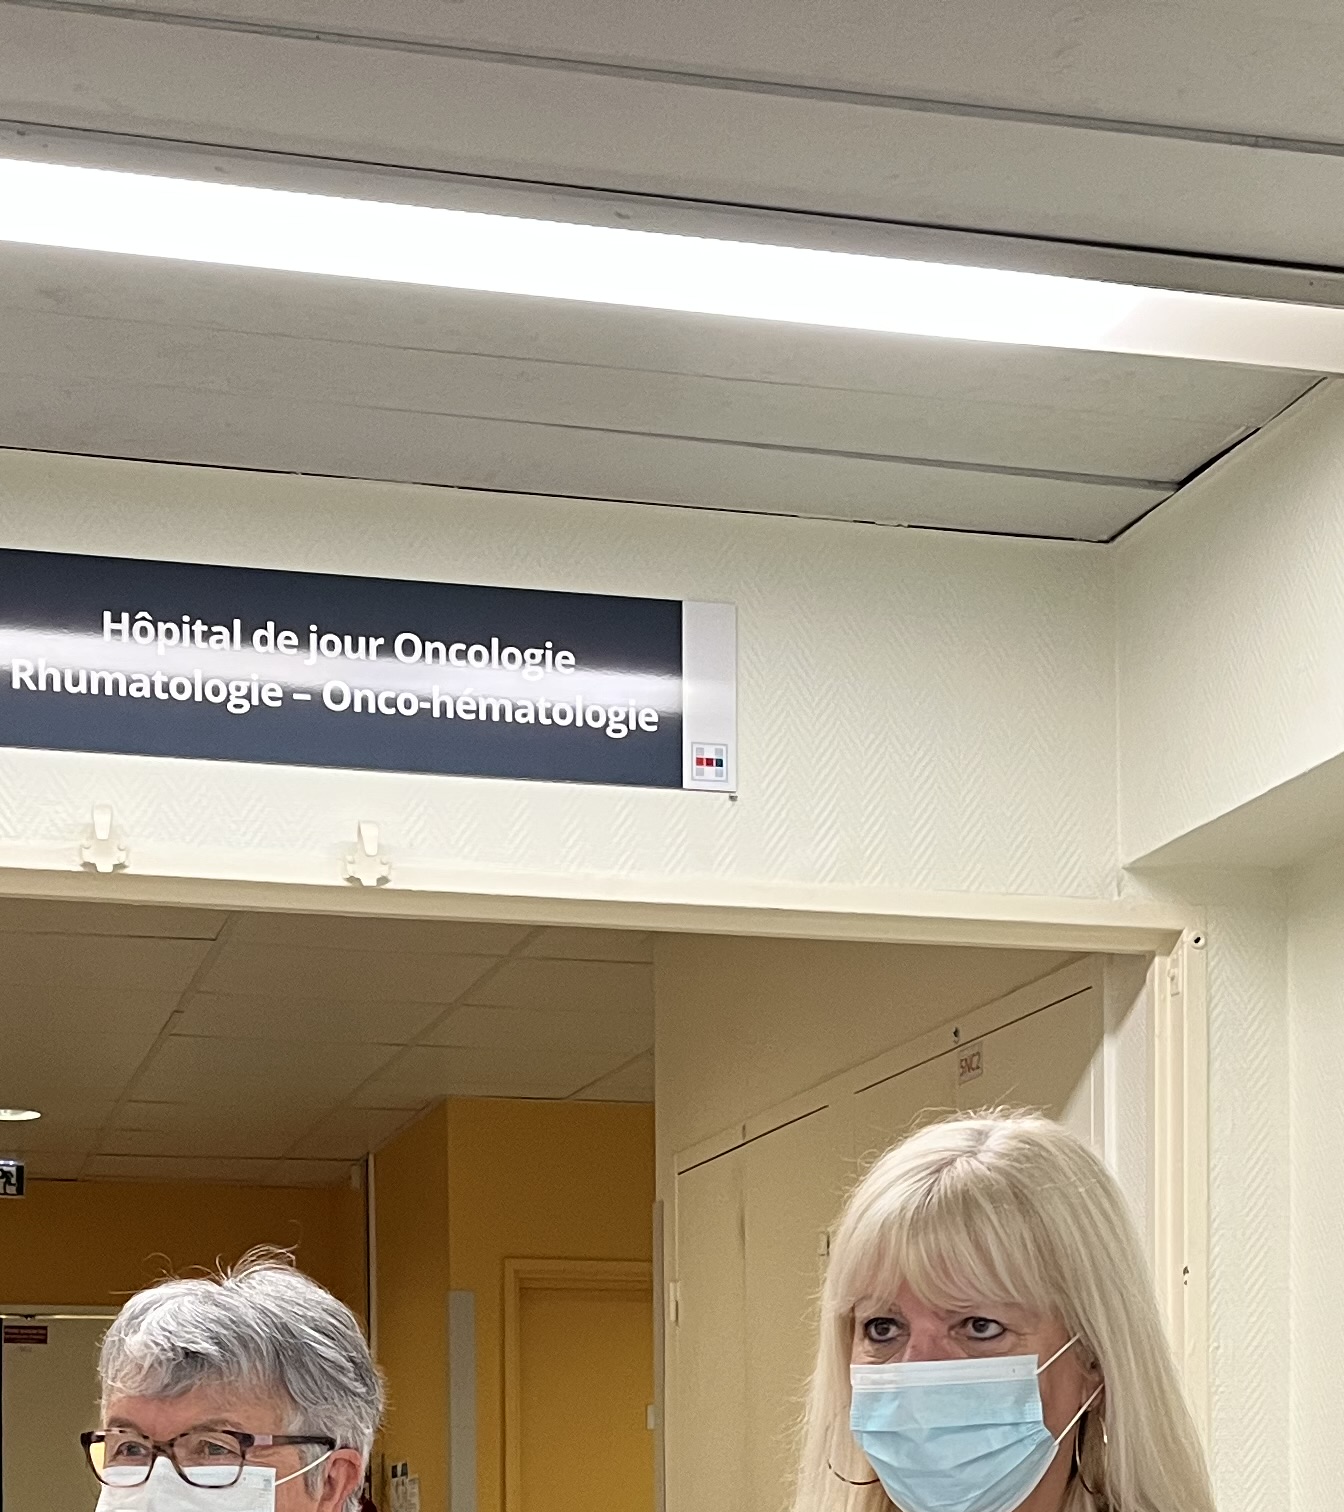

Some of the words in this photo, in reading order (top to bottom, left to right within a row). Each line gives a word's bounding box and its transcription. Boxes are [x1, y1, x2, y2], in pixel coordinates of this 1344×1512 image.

[101, 609, 242, 656] Hôpital
[251, 620, 300, 655] de
[303, 624, 386, 666] jour
[393, 631, 577, 682] Oncologie
[10, 657, 284, 715] Rhumatologie
[321, 679, 660, 739] Onco-hématologie
